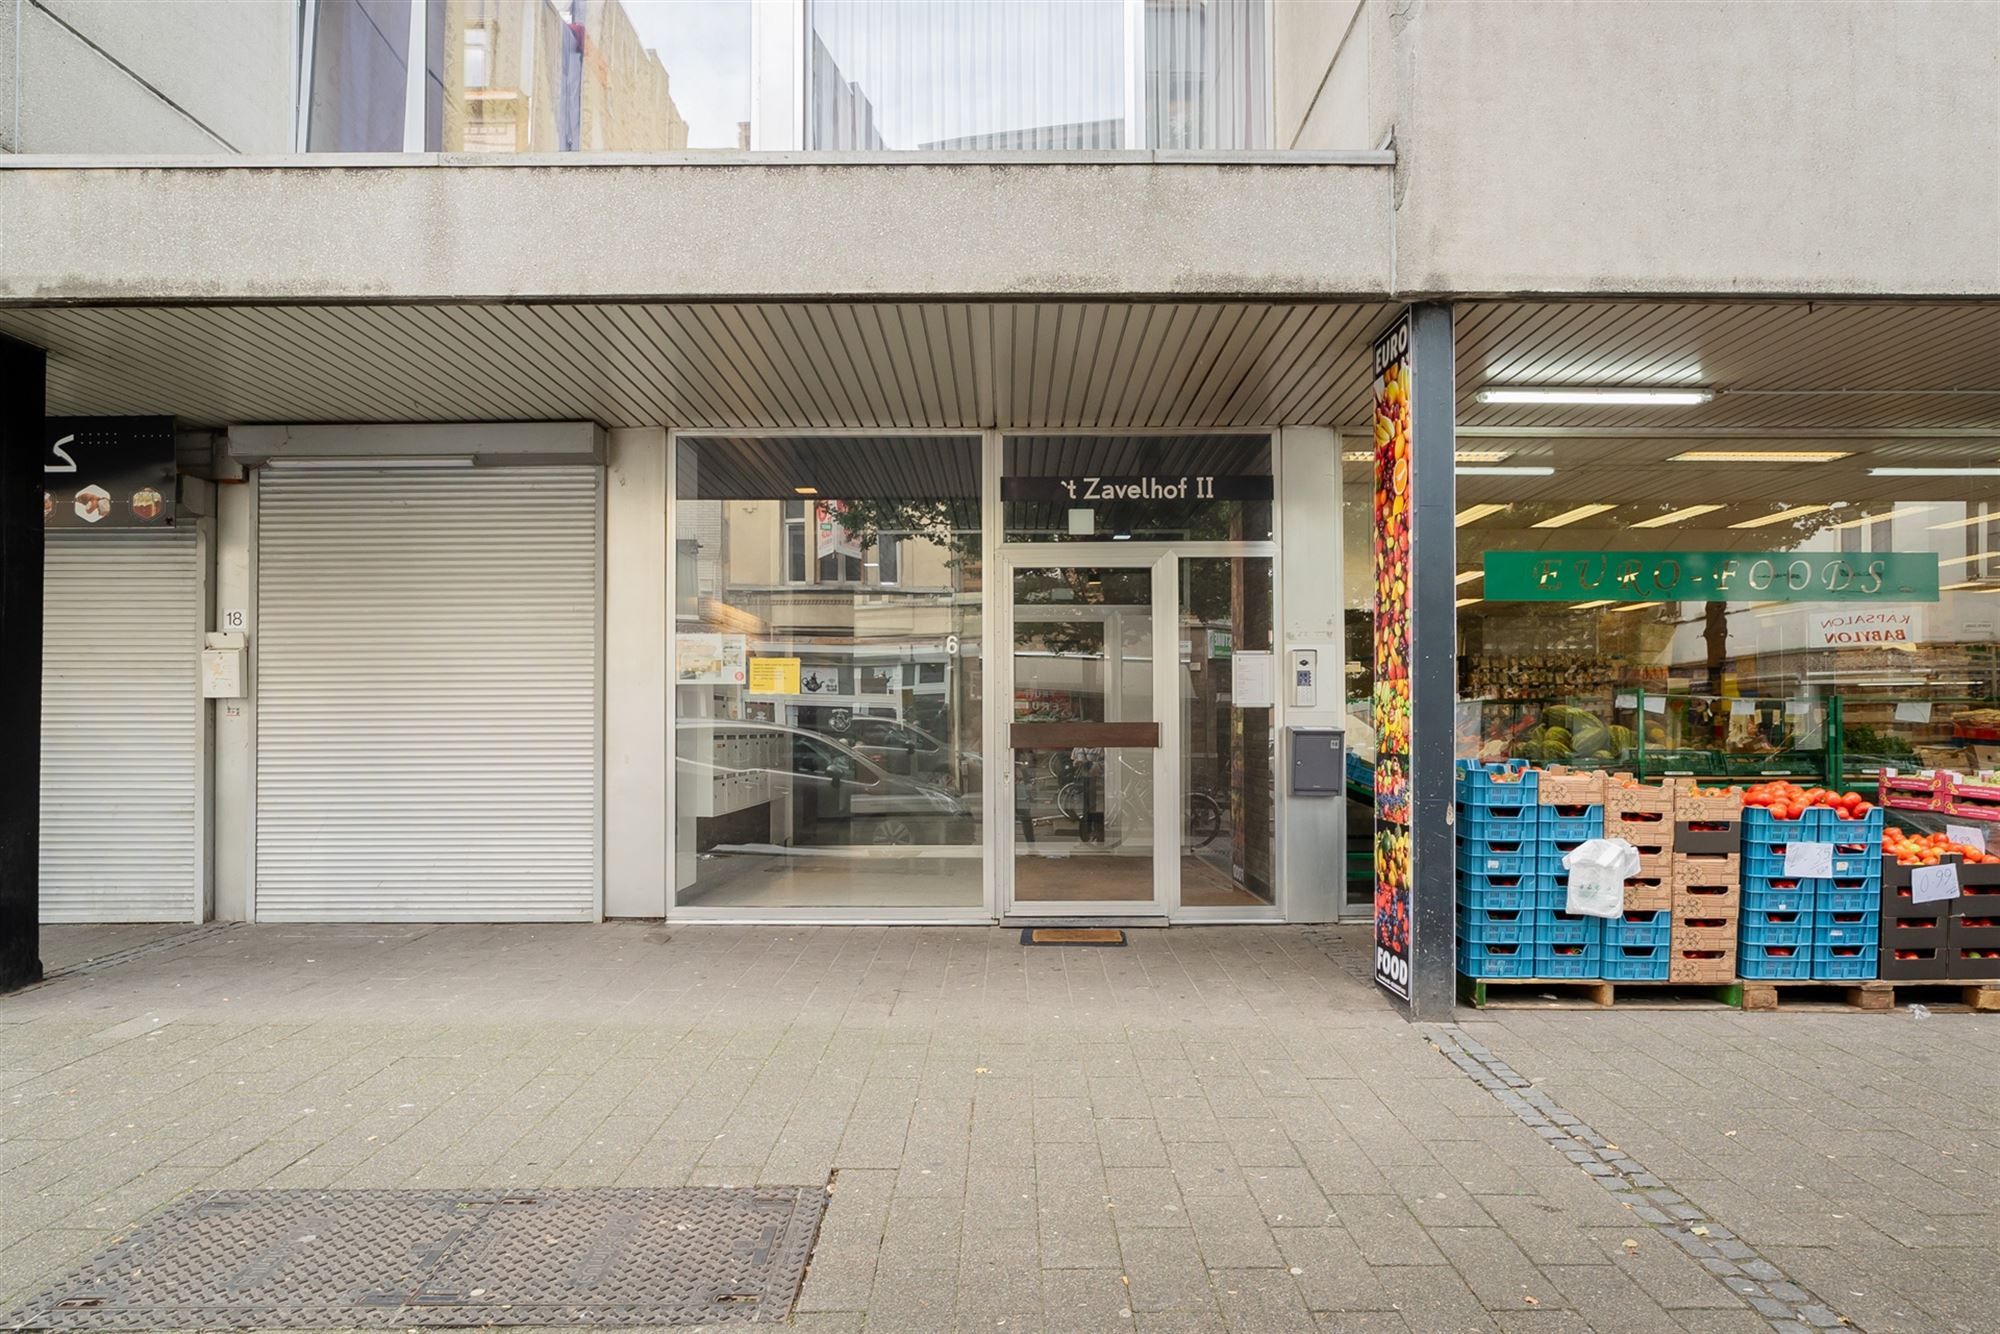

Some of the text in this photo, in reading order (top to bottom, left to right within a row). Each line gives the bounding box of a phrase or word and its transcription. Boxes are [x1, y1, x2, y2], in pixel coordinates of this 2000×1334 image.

[1376, 324, 1408, 375] EURO
[1083, 477, 1188, 500] Zavelhof
[1196, 476, 1214, 499] II
[226, 611, 243, 626] 18
[946, 635, 958, 654] 6
[1377, 946, 1408, 986] FOOD
